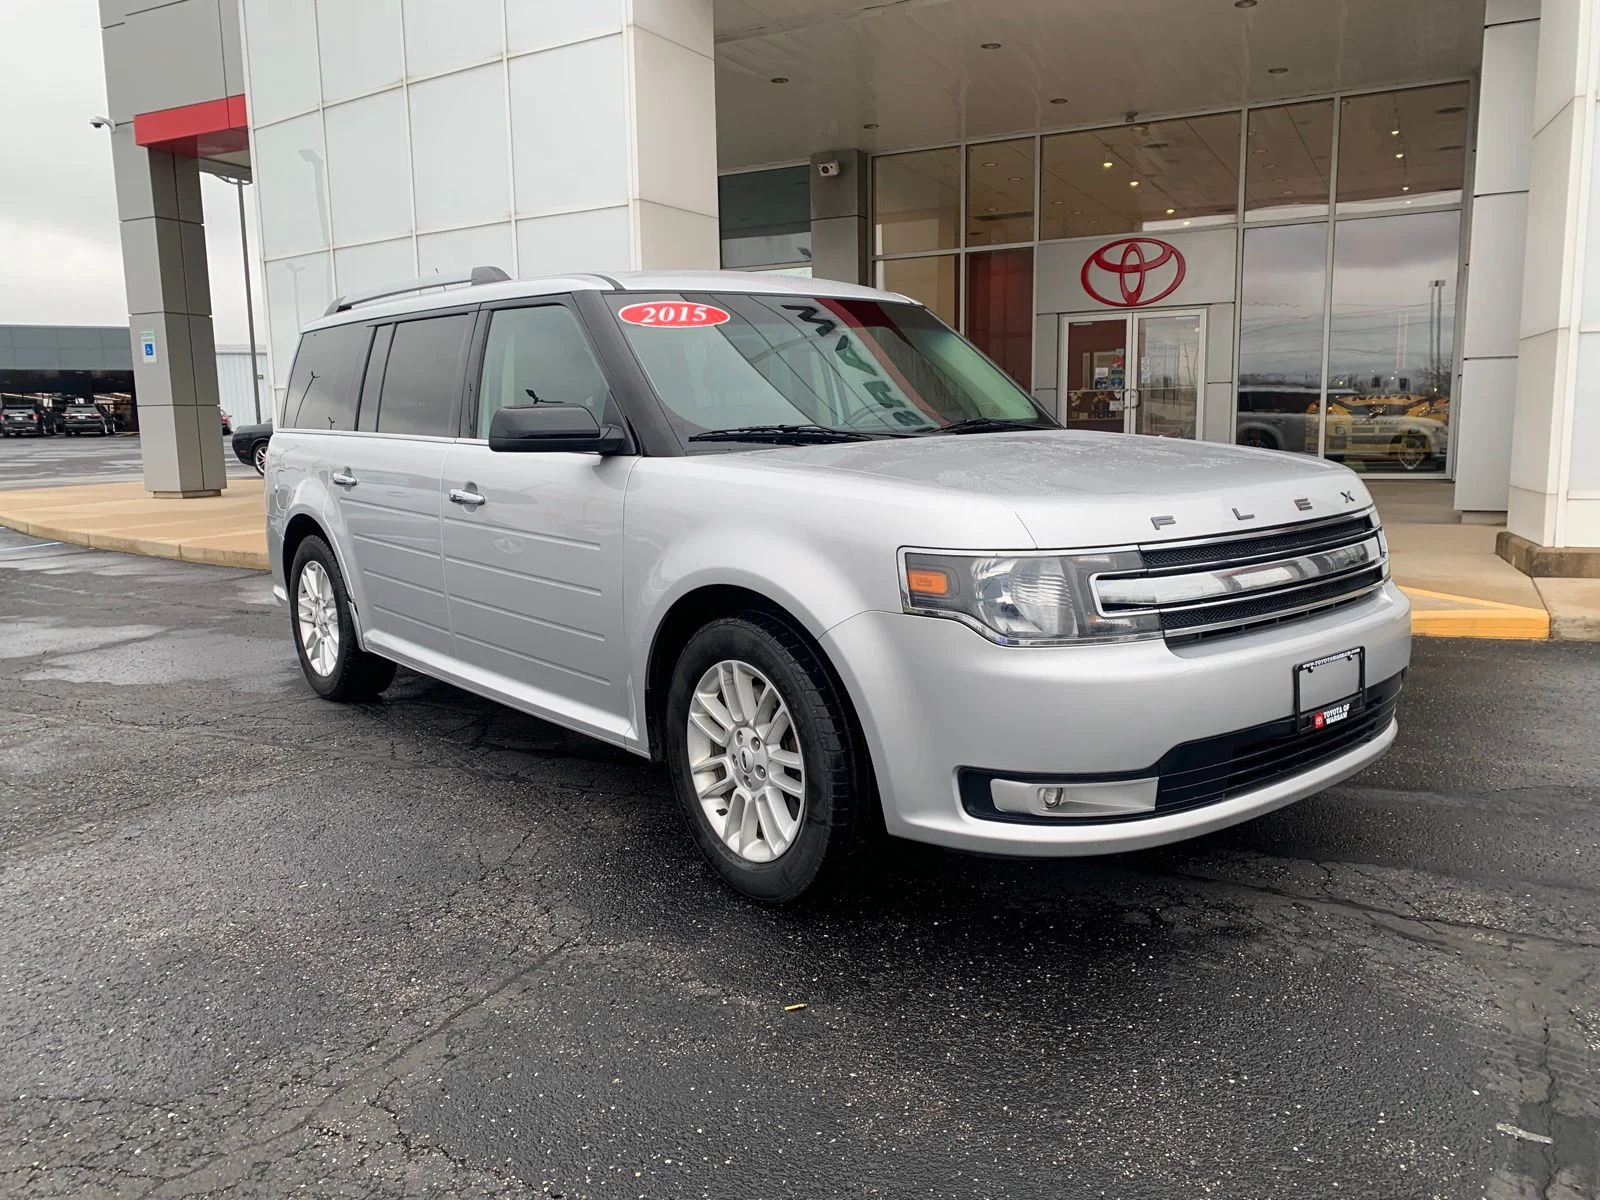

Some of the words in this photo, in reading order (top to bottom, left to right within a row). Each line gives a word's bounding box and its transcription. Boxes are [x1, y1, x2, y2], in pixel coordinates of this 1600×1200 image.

[640, 306, 708, 323] 2015
[1150, 490, 1356, 531] FLEX
[1323, 707, 1342, 718] TOYOTA
[1326, 712, 1347, 724] WARSAW
